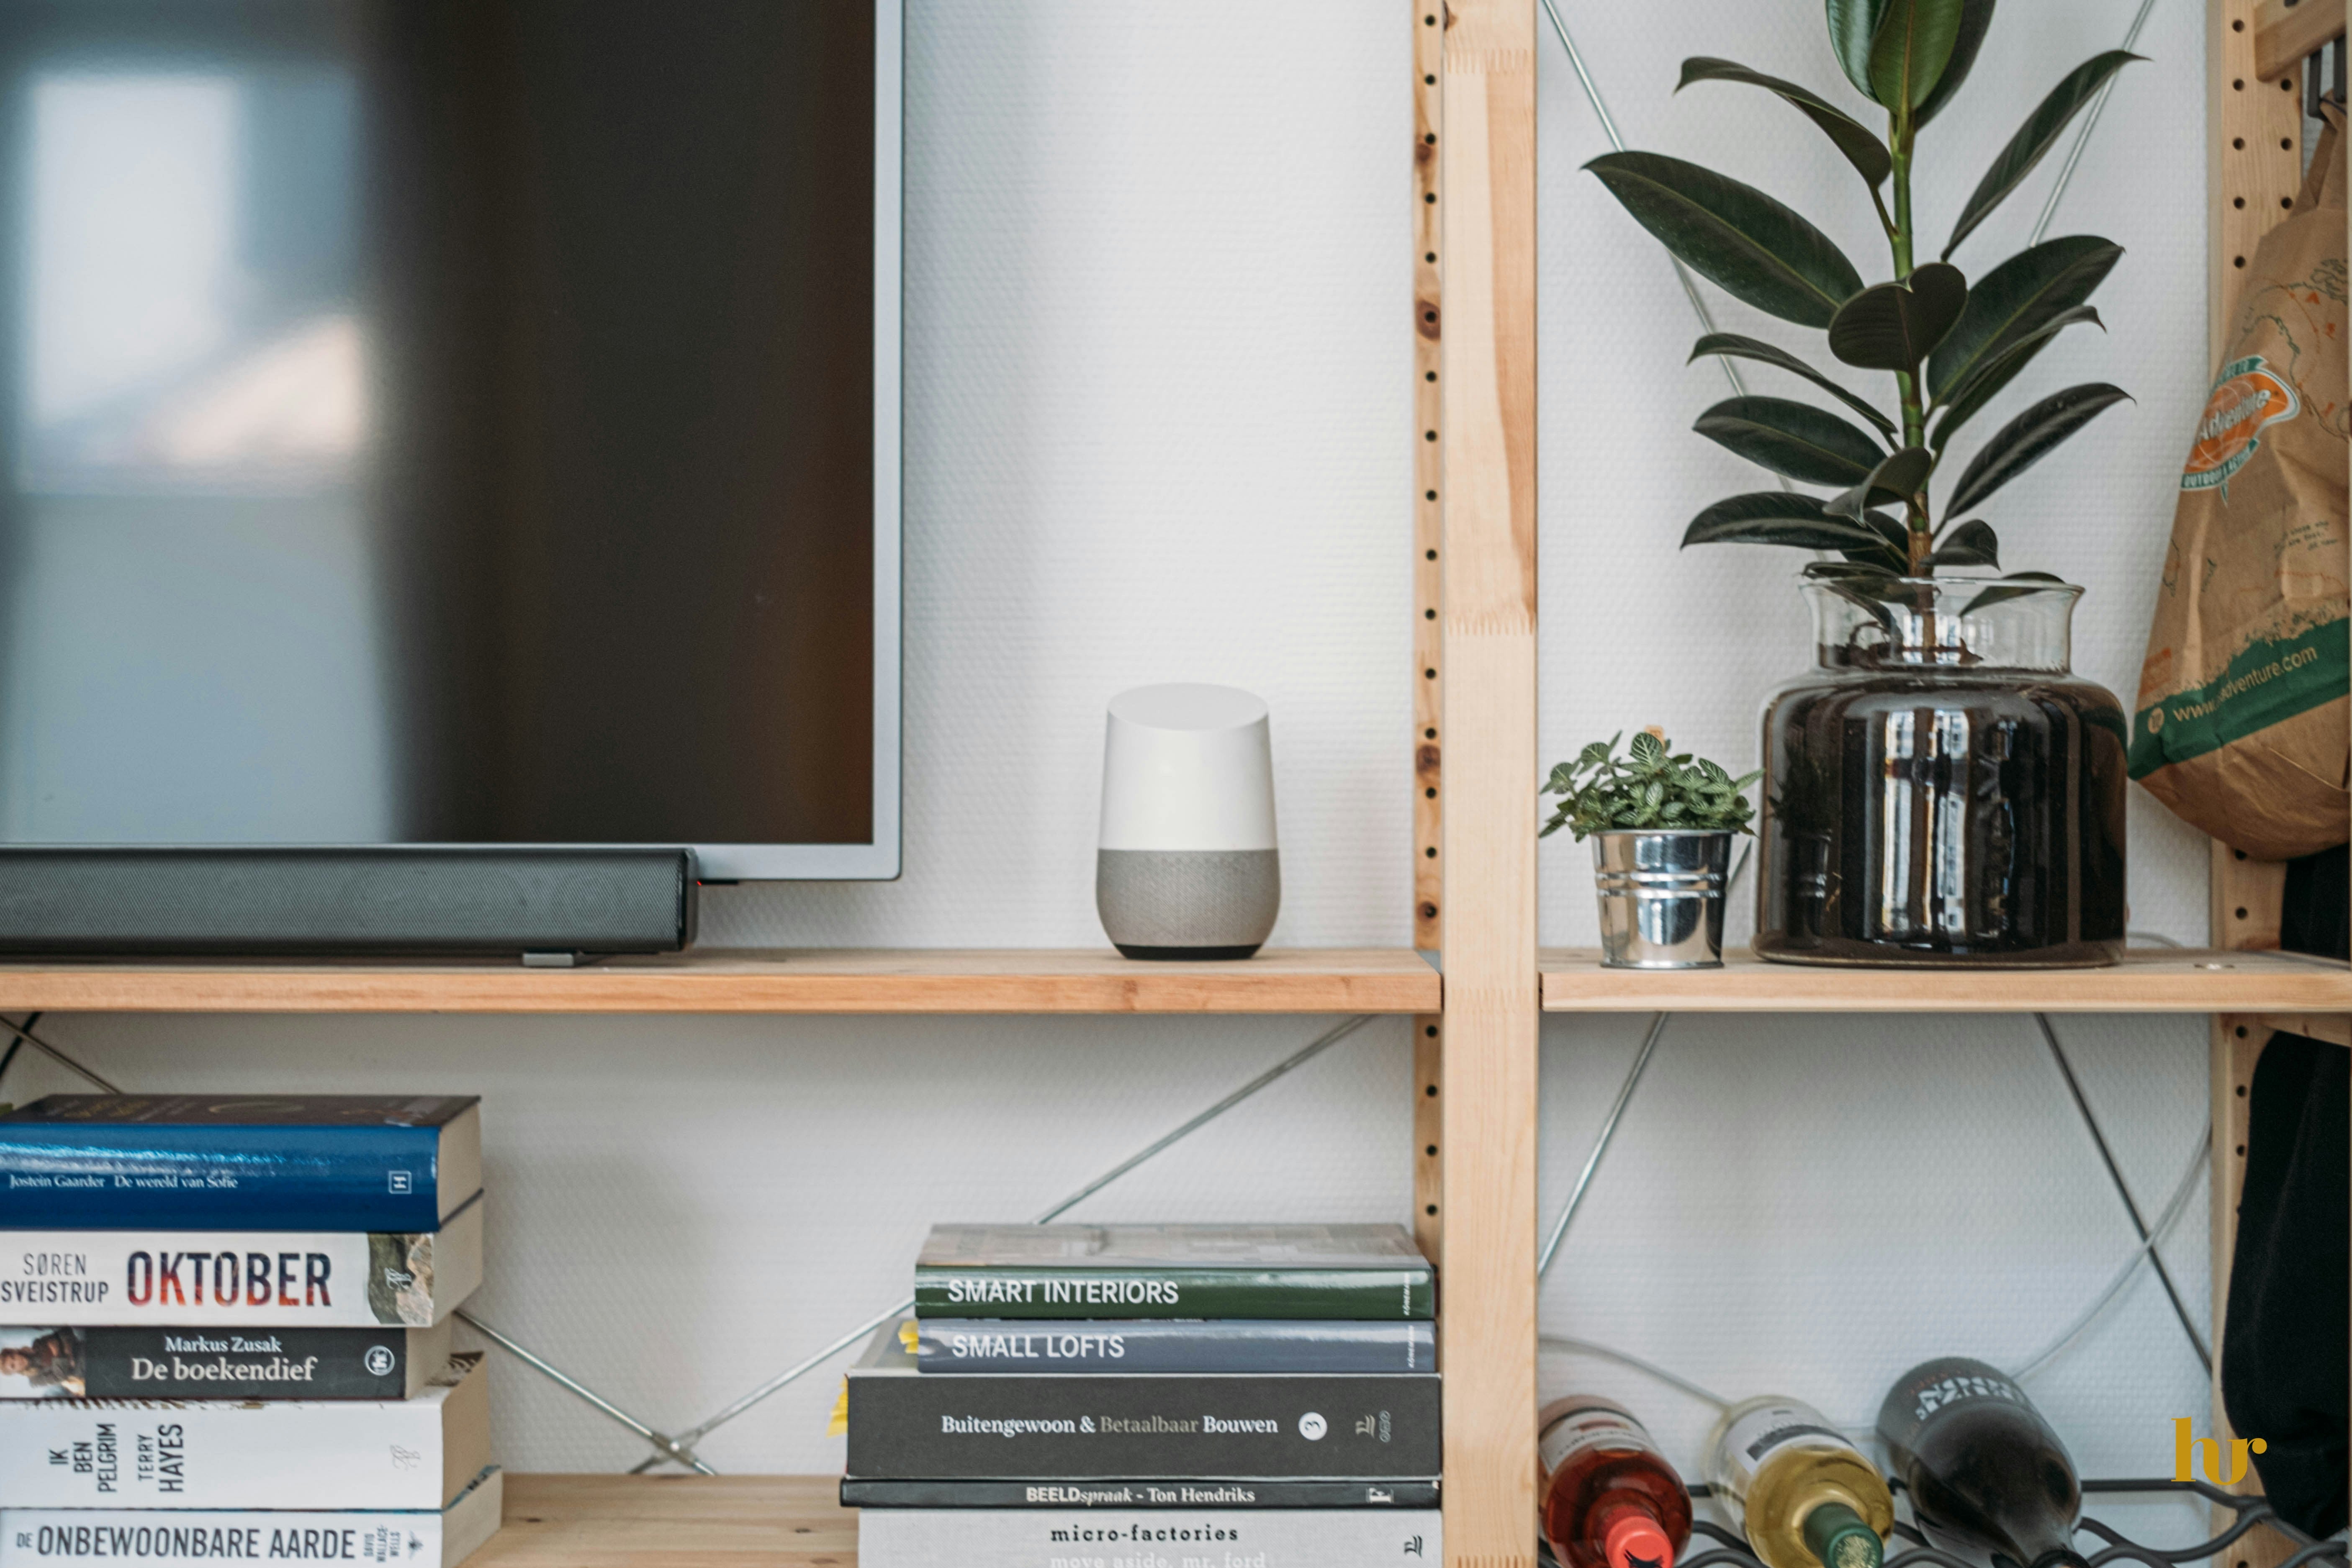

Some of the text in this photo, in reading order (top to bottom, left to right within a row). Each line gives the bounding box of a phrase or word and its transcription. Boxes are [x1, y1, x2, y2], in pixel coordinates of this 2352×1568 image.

[10, 1174, 239, 1189] Jostein Gaarder De wereld van Sofie
[23, 1253, 87, 1276] SØREN
[127, 1250, 332, 1306] OKTOBER
[0, 1281, 109, 1303] SVEISTRUP
[948, 1279, 1179, 1304] SMART INTERIORS
[165, 1336, 283, 1353] Markus Zusak
[952, 1335, 1125, 1358] SMALL LOFTS
[131, 1356, 319, 1380] De boekendief
[941, 1415, 1279, 1438] Buitengewoon & Betaalbaar Bouwen
[49, 1448, 69, 1465] IK
[73, 1442, 93, 1474] BEN
[96, 1422, 118, 1493] PELGRIM
[138, 1434, 154, 1481] TERRY
[158, 1423, 184, 1493] HAYES
[1026, 1486, 1133, 1506] BEELDspraak
[1146, 1487, 1177, 1502] Ton
[1181, 1487, 1255, 1502] Hendriks
[16, 1526, 356, 1559] DE ONBEWOONBARE AARDE
[1051, 1524, 1238, 1541] micro-factories
[1050, 1557, 1105, 1568] move
[1224, 1551, 1266, 1568] ford
